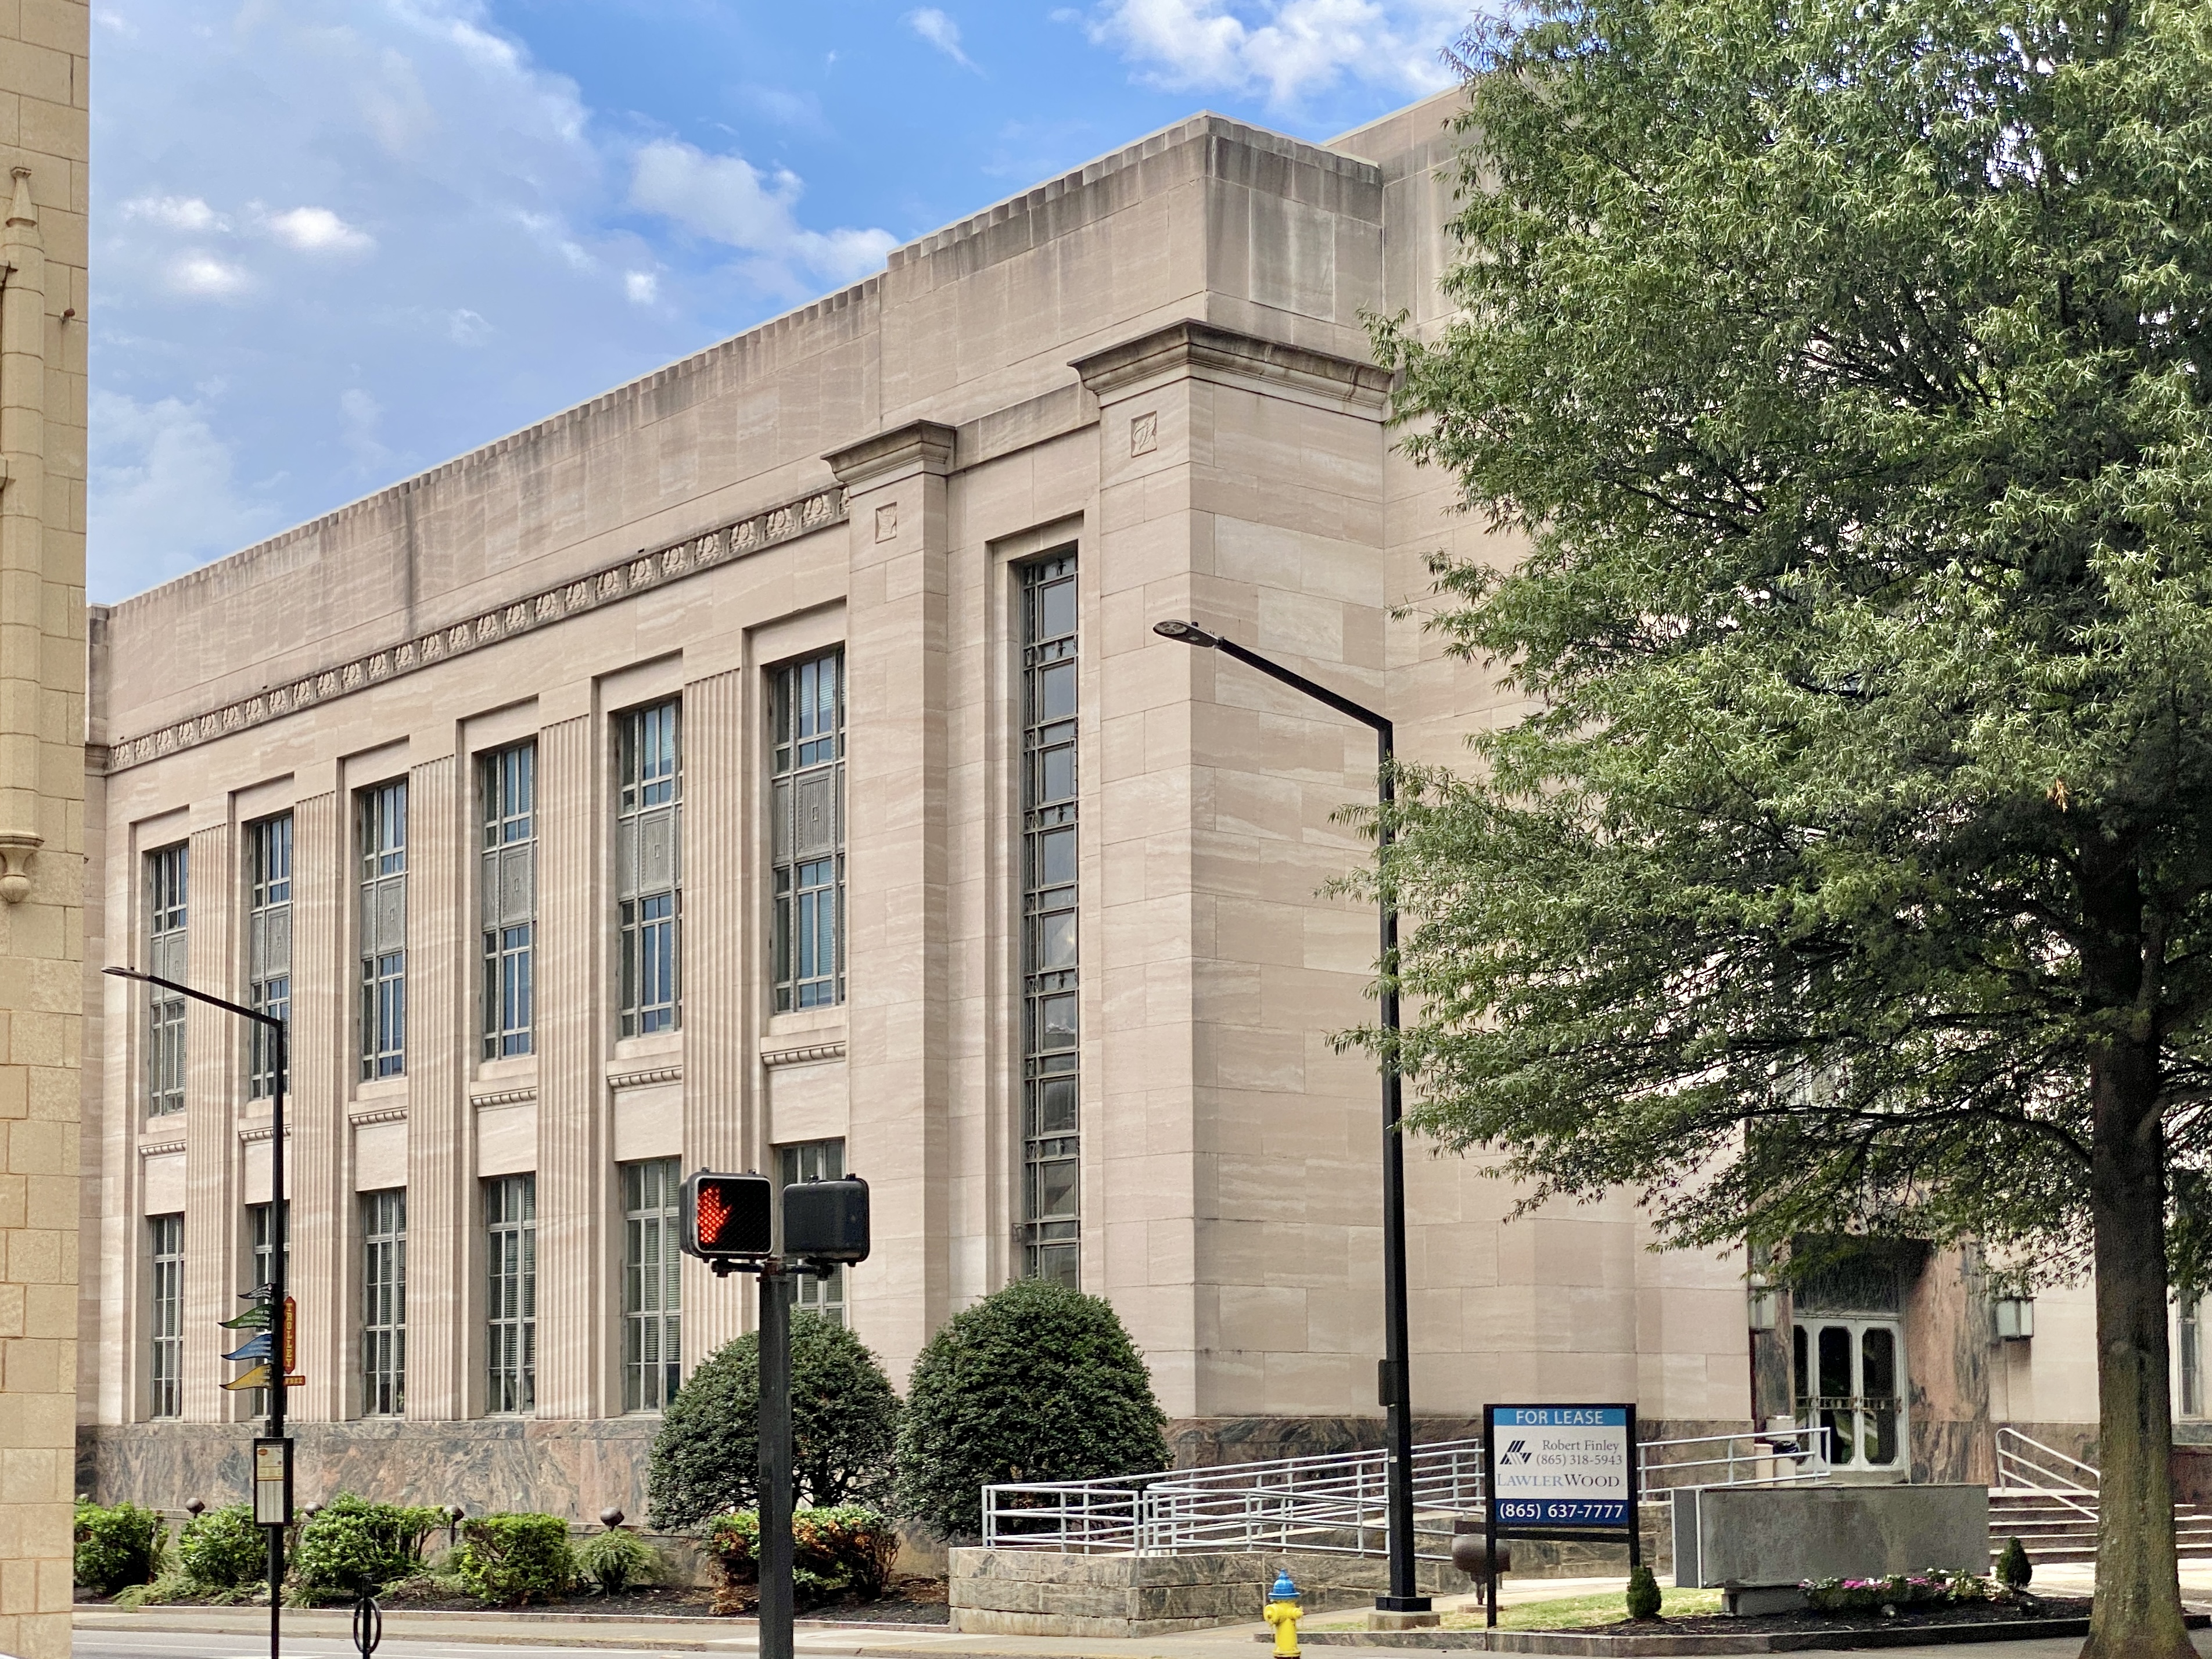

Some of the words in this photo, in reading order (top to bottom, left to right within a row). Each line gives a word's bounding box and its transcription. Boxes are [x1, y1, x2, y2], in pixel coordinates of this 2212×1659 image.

[1516, 1411, 1547, 1424] FOR
[1554, 1411, 1603, 1424] LEASE
[1542, 1440, 1580, 1450] Robert
[1585, 1439, 1619, 1453] Finley
[1536, 1453, 1566, 1466] (865)
[1570, 1455, 1622, 1464] 318-5943
[1500, 1503, 1541, 1520] (865)
[1548, 1504, 1624, 1518] 637-7777
